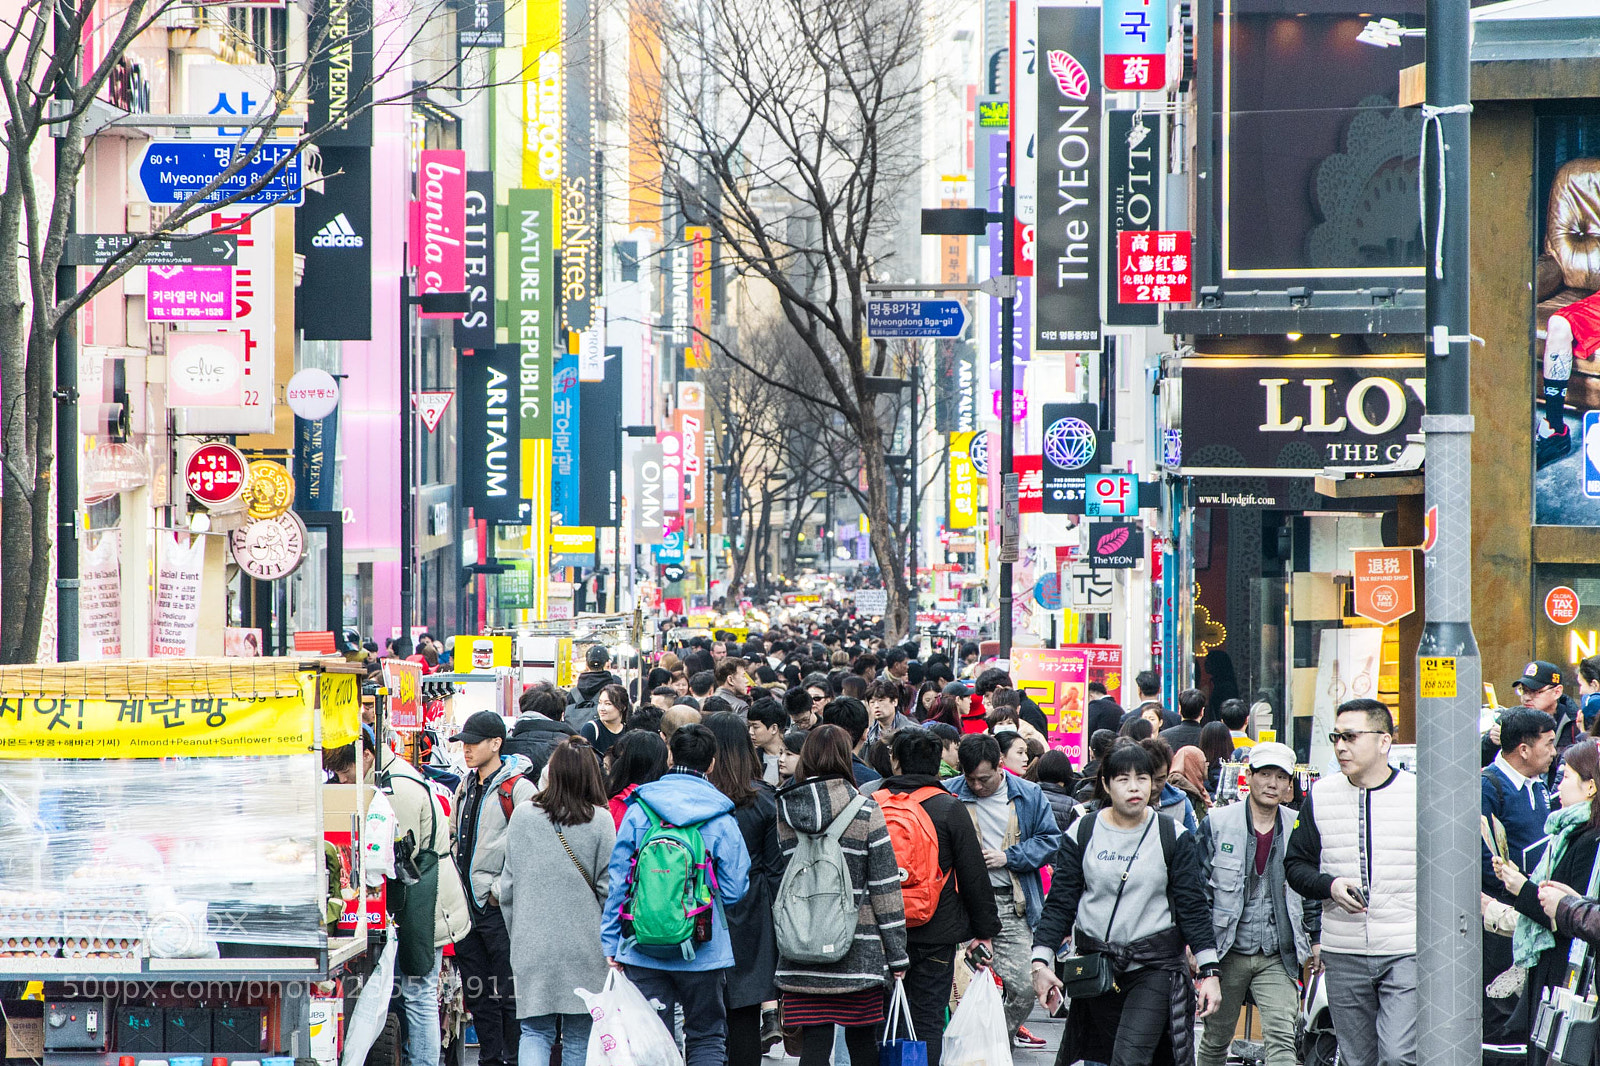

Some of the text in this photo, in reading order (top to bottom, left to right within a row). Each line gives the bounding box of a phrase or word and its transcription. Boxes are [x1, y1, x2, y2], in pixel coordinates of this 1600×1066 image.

[1120, 12, 1151, 43] 국
[1123, 57, 1150, 85] 药
[151, 155, 179, 165] 60 1
[1128, 146, 1152, 231] LLO
[1058, 106, 1089, 288] YEON The
[425, 162, 461, 264] banila
[312, 231, 363, 248] adidas
[463, 190, 488, 328] GUESS
[200, 291, 224, 303] Nail
[1136, 285, 1171, 301] 2楼
[521, 210, 540, 419] NATURE REPUBLIC
[870, 302, 921, 316] 명동8가길
[870, 317, 953, 327] Myeongdong 8ga-gil
[186, 356, 225, 375] clue
[245, 391, 259, 406] 22
[422, 394, 447, 404] UESS
[487, 366, 507, 497] ARITAUM
[1327, 443, 1378, 461] THE
[310, 451, 323, 499] WEENIE
[1587, 480, 1600, 492] NB
[1096, 477, 1131, 514] 약
[1199, 493, 1275, 506] www.lloydgift.com
[1093, 556, 1133, 565] The YEON
[1368, 558, 1400, 574] 退税
[1376, 594, 1392, 602] TAX
[1552, 599, 1573, 609] TAX
[1553, 609, 1573, 617] FREE
[130, 734, 303, 746] Almond+Peanut+Sunflower seed
